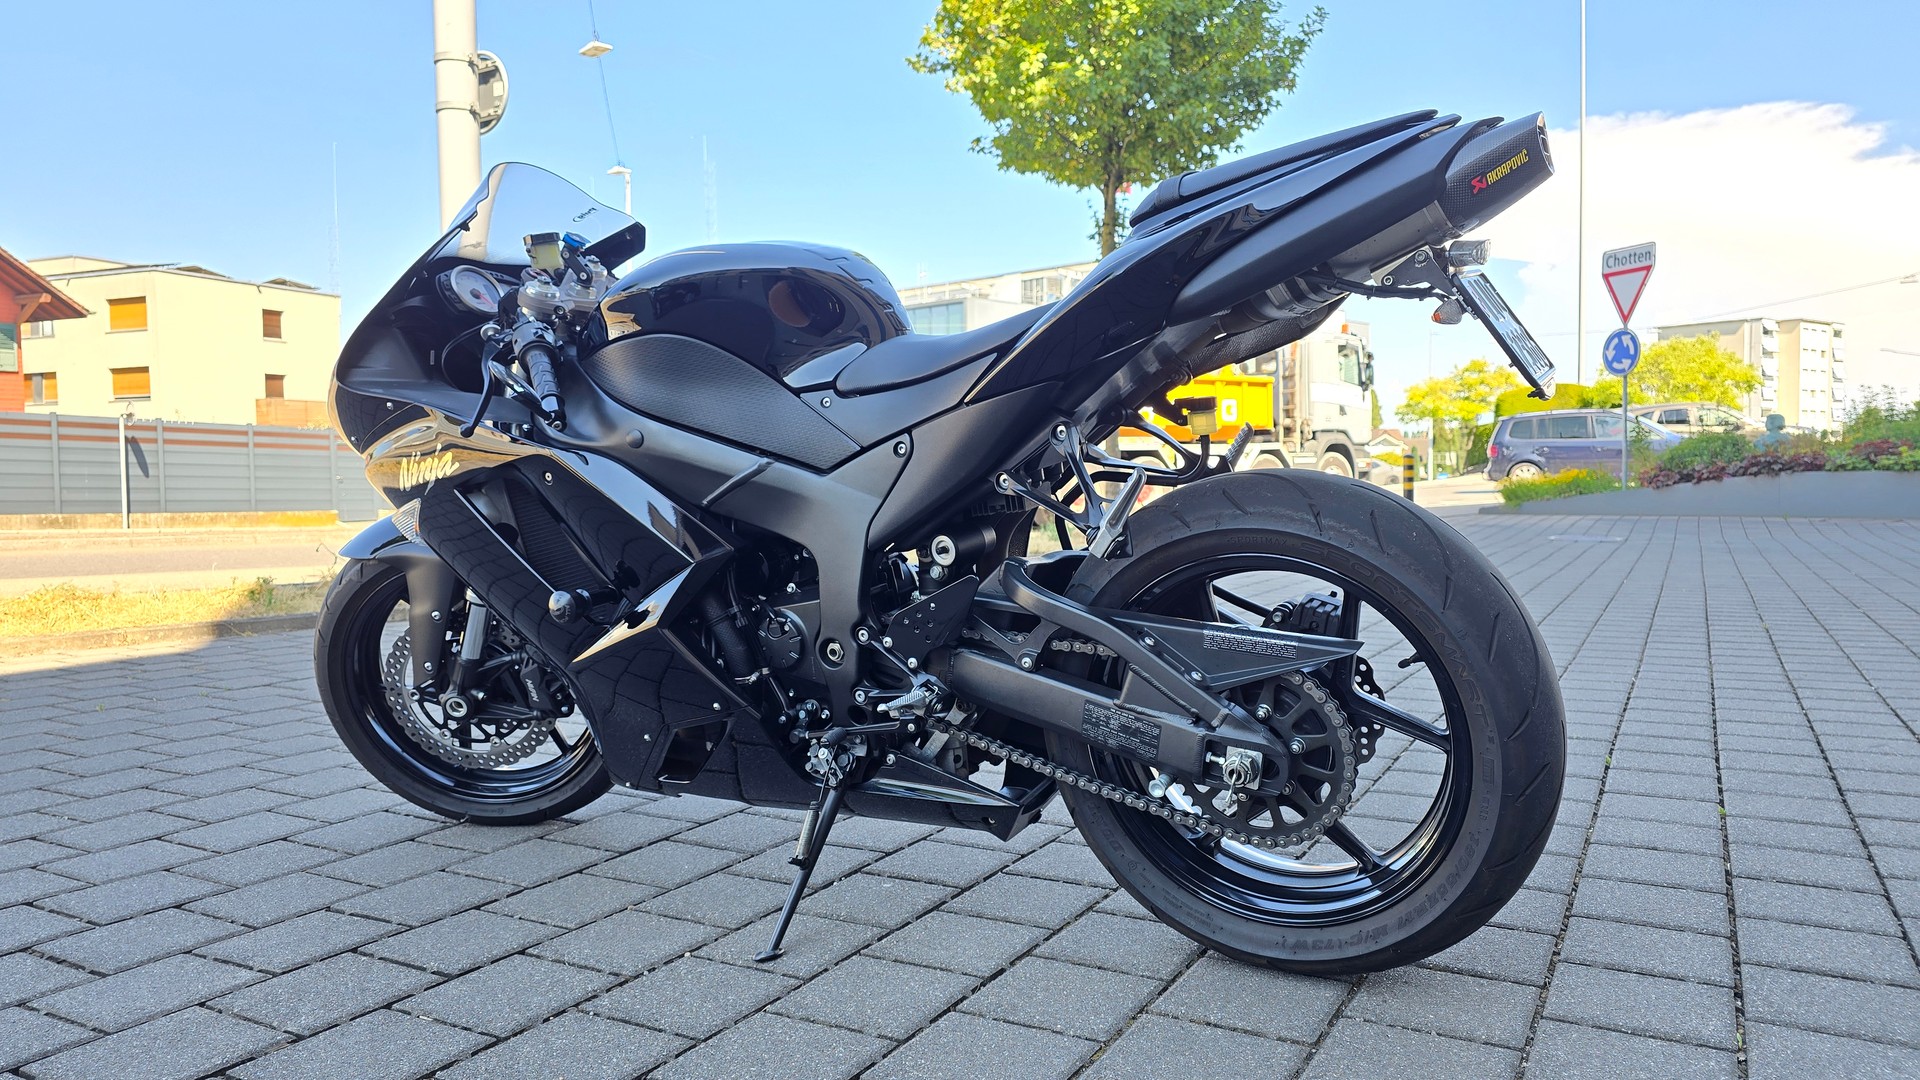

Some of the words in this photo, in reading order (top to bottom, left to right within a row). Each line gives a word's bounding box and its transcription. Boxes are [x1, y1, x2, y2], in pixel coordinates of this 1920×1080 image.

[1605, 250, 1652, 269] Chotten
[399, 443, 460, 495] Ninja
[1229, 536, 1287, 546] SPORTMAX
